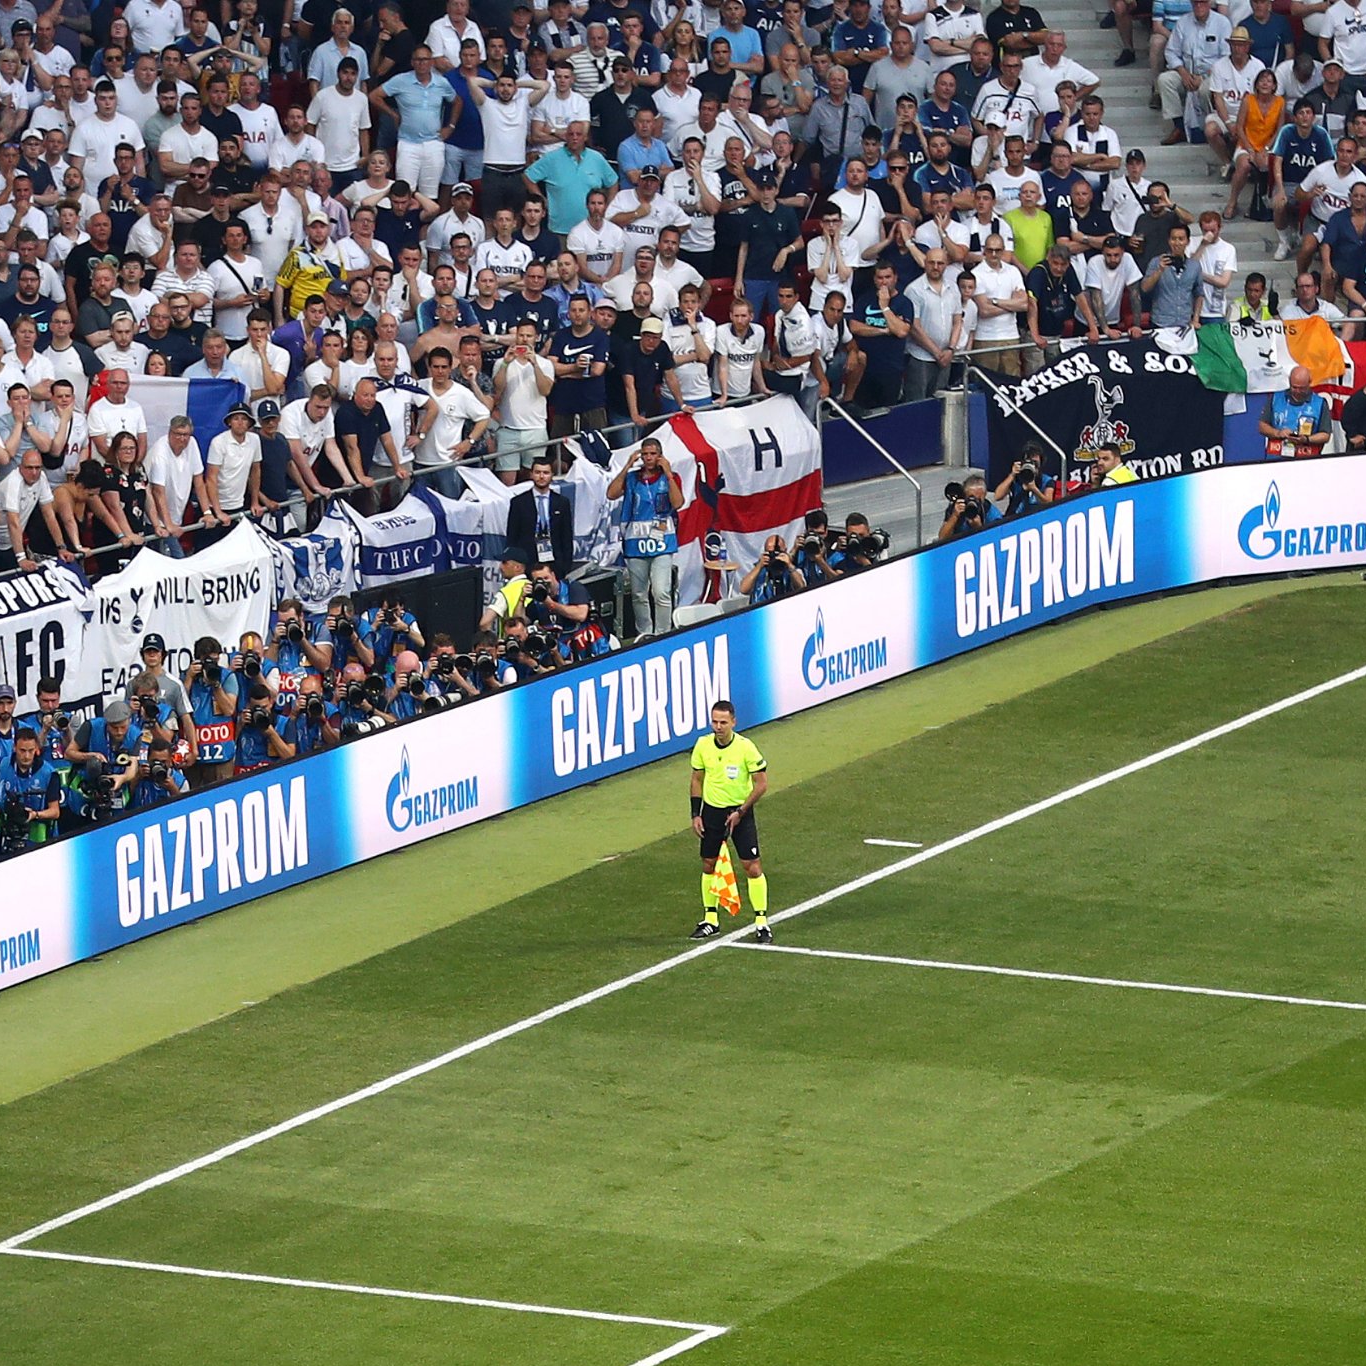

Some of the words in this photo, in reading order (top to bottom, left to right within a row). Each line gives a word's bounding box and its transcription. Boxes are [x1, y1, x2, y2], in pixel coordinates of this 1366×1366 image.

[1003, 111, 1023, 122] IA
[908, 151, 925, 164] IA
[1290, 153, 1317, 167] AIA
[1057, 195, 1072, 208] AI
[1252, 322, 1297, 339] Spurs
[1107, 349, 1133, 374] &
[749, 427, 783, 472] H
[373, 545, 426, 570] THFC
[955, 499, 1134, 638] GAZPROM
[202, 566, 261, 606] BRING
[827, 636, 888, 686] GAZPROM
[551, 633, 731, 778] GAZPROM
[412, 777, 479, 828] GAZPROM
[114, 774, 310, 929] GAZPROM
